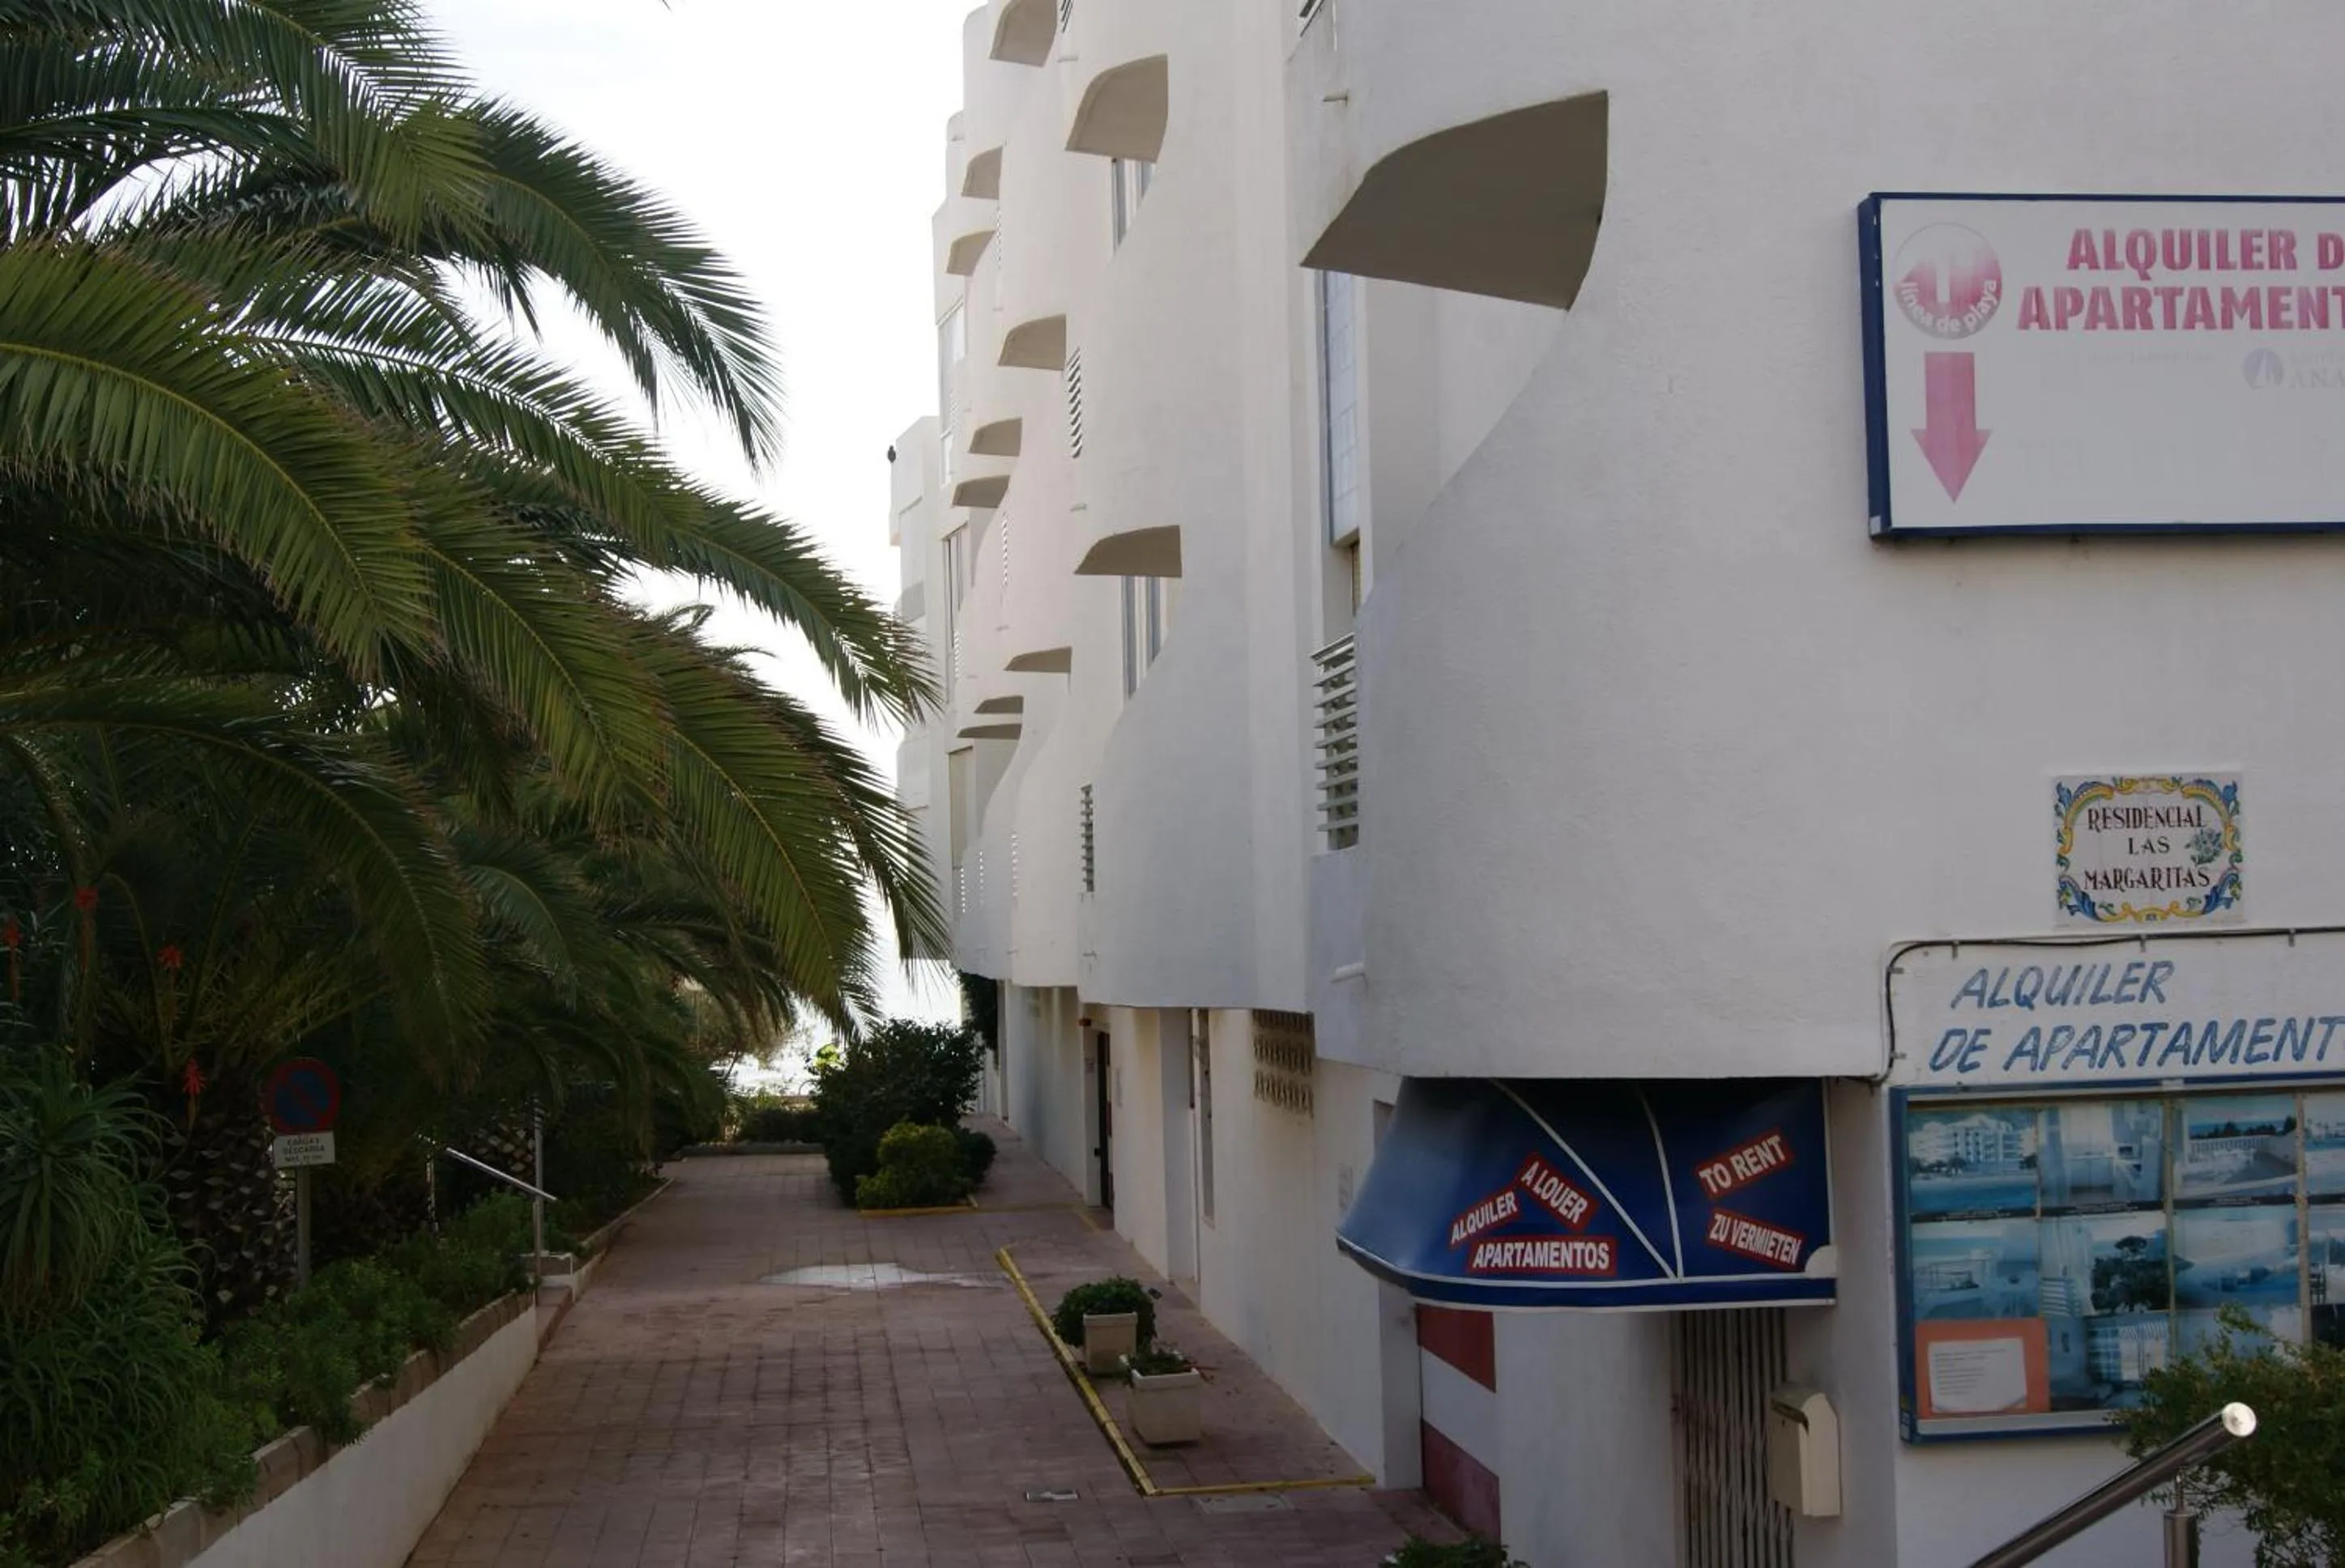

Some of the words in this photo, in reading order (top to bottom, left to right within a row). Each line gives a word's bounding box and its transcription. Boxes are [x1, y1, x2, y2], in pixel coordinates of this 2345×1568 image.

[2066, 228, 2297, 281] ALQUILER
[1937, 313, 1960, 333] de
[1963, 279, 1998, 331] playa
[2087, 805, 2207, 832] RESIDENCIAL
[2128, 836, 2170, 854] LAS
[2084, 867, 2210, 892] MARGARITAS
[1950, 960, 2175, 1011] ALQUILER
[1929, 1028, 1991, 1073] DE
[1699, 1163, 1732, 1193] TO
[1730, 1135, 1785, 1181] RENT
[1451, 1191, 1518, 1244] ALQUILER
[1521, 1161, 1539, 1187] A
[1533, 1170, 1588, 1224] LOUER
[1473, 1241, 1610, 1269] APARTAMENTOS
[1710, 1213, 1731, 1242] ZU
[1730, 1219, 1801, 1264] VERMIETEN
